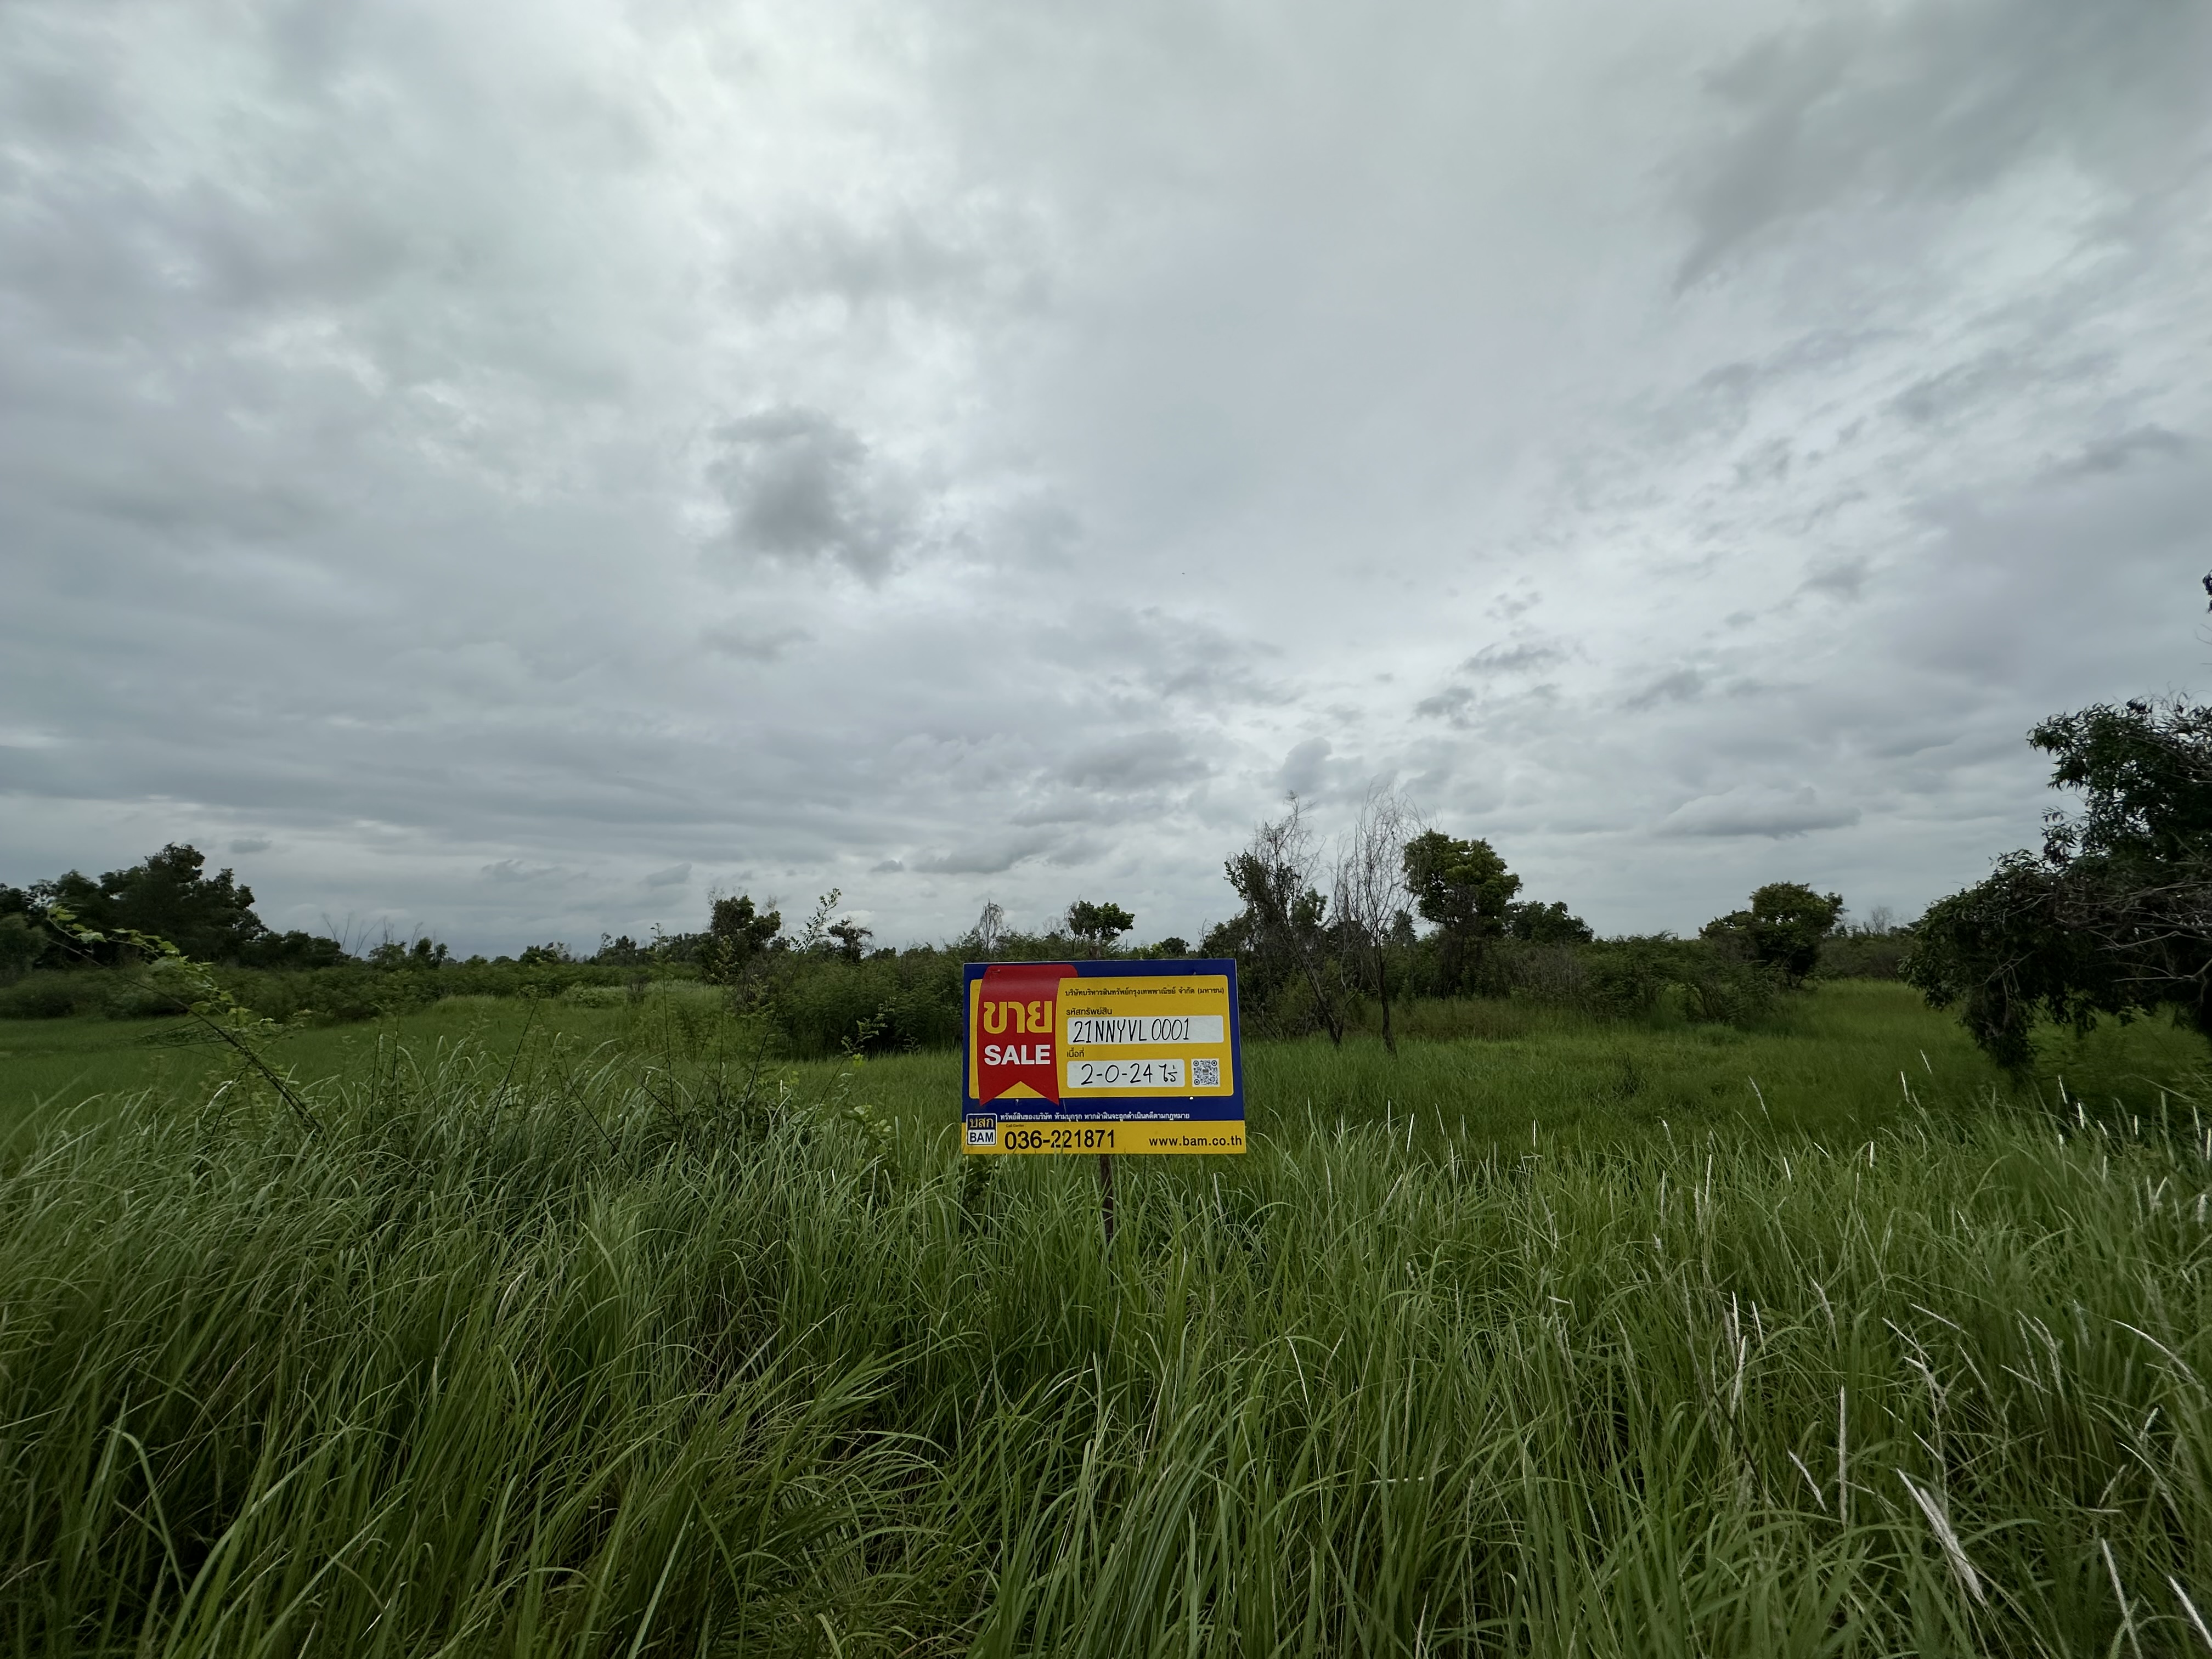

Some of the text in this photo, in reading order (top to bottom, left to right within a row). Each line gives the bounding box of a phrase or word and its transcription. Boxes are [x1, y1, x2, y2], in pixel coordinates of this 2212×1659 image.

[1065, 987, 1176, 997] บริษัทบริหารสินทรัพย์กรุงเทพพาณิชย์
[1178, 986, 1195, 995] จำกัด
[1066, 1007, 1113, 1015] รหัสทรัพย์สิน
[984, 1001, 1052, 1034] ขาย
[1073, 1018, 1189, 1043] 21NNYVL0001
[984, 1045, 1051, 1065] SALE
[1066, 1047, 1085, 1058] เนื้อที่
[1081, 1063, 1178, 1085] 2-0-24 ไร่
[1000, 1111, 1052, 1120] ทรัพย์สินของบริษัท
[1054, 1112, 1082, 1122] ห้ามบุกรุก
[969, 1117, 994, 1128] บสก
[969, 1132, 994, 1143] BAM
[1005, 1129, 1114, 1150] 036-221871
[1149, 1135, 1242, 1146] www.bam.co.th
